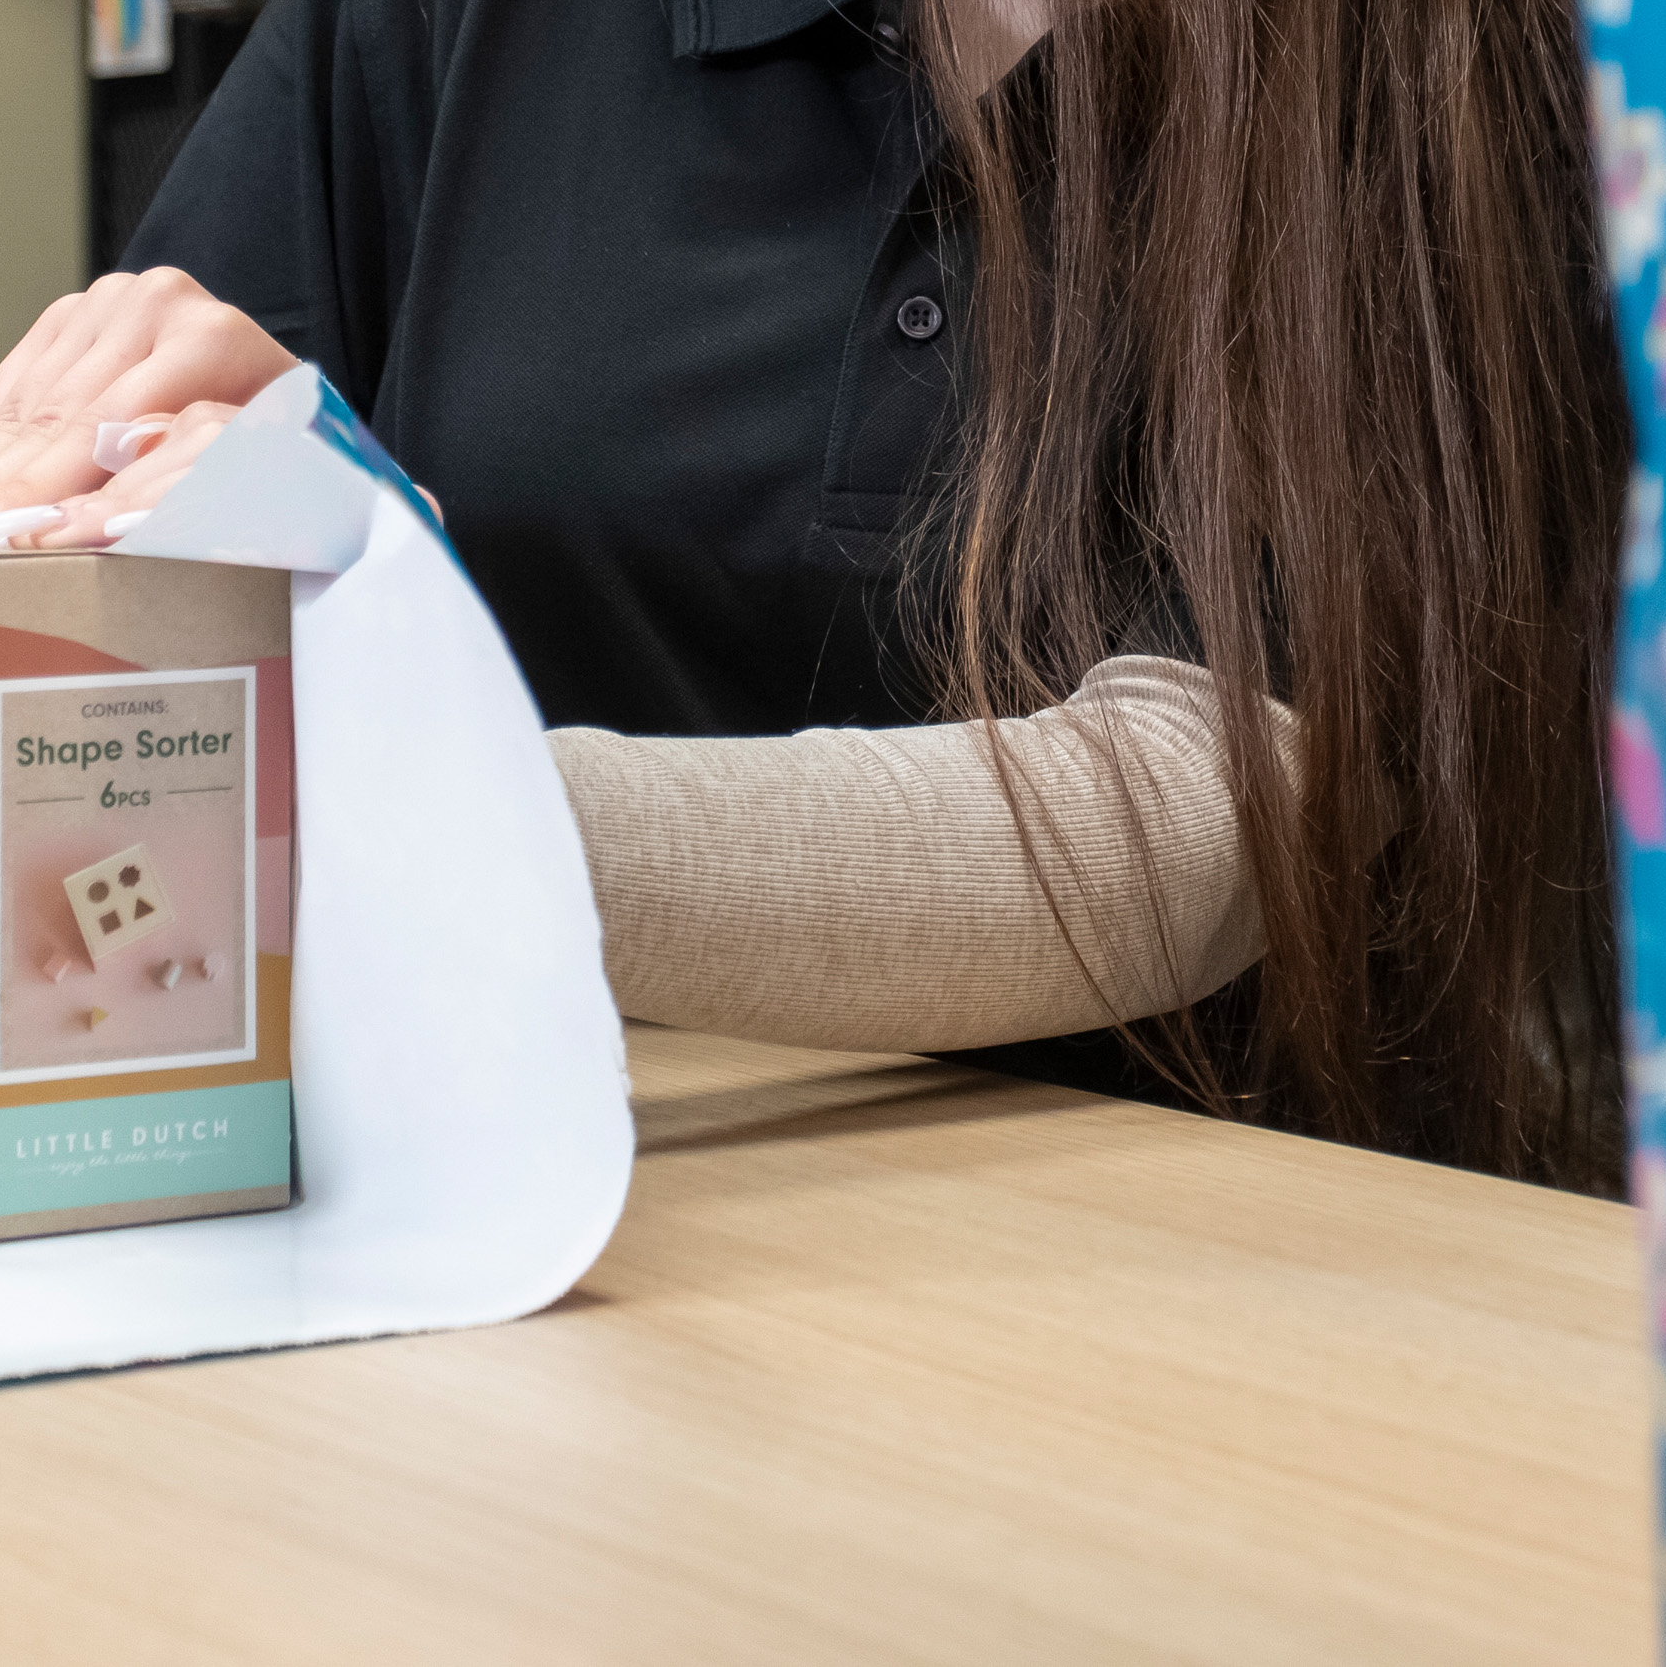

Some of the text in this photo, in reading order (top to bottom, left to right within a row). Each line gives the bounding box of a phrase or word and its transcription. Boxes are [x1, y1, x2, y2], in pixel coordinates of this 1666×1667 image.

[81, 699, 169, 719] CONTAINS:
[16, 729, 232, 771] Shape Sorter
[16, 1118, 229, 1159] LITTLE DUTCH
